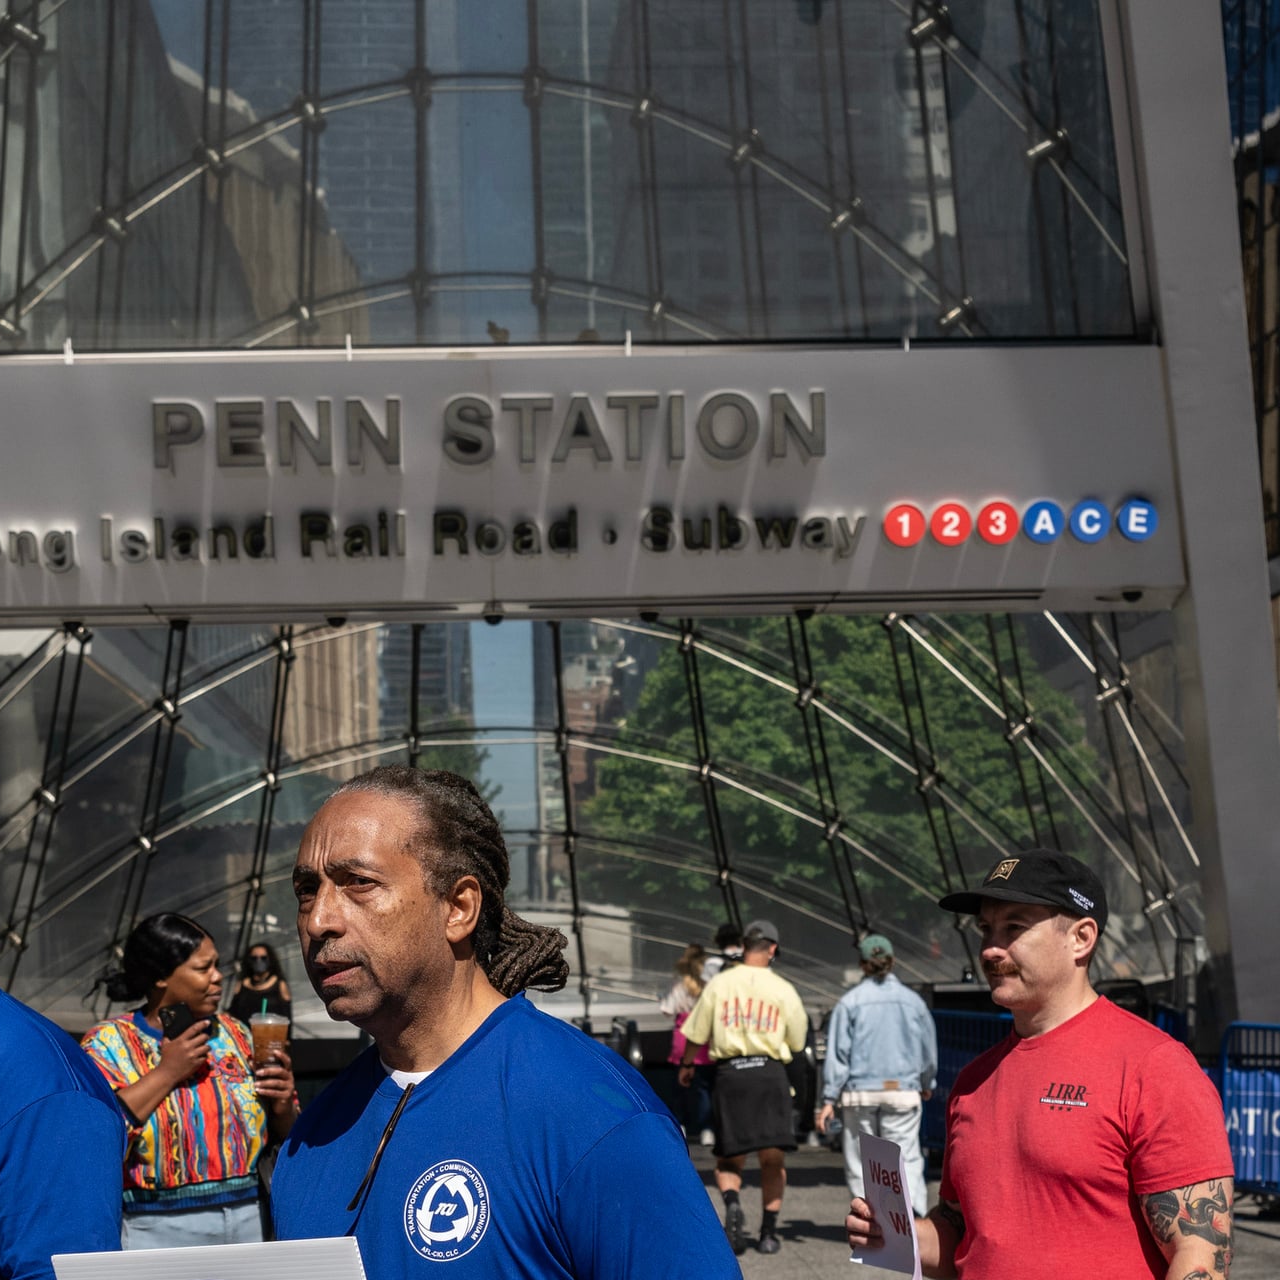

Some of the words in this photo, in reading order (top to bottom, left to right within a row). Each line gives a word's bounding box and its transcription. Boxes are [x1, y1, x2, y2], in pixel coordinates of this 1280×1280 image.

[152, 395, 404, 472] PENN
[442, 390, 827, 464] STATION
[100, 512, 276, 564] Island
[299, 509, 406, 559] Rail
[433, 507, 578, 556] Road
[642, 505, 867, 559] Subway
[1045, 1082, 1087, 1101] LIRR
[869, 1159, 903, 1194] Wag
[445, 1247, 460, 1258] CLC
